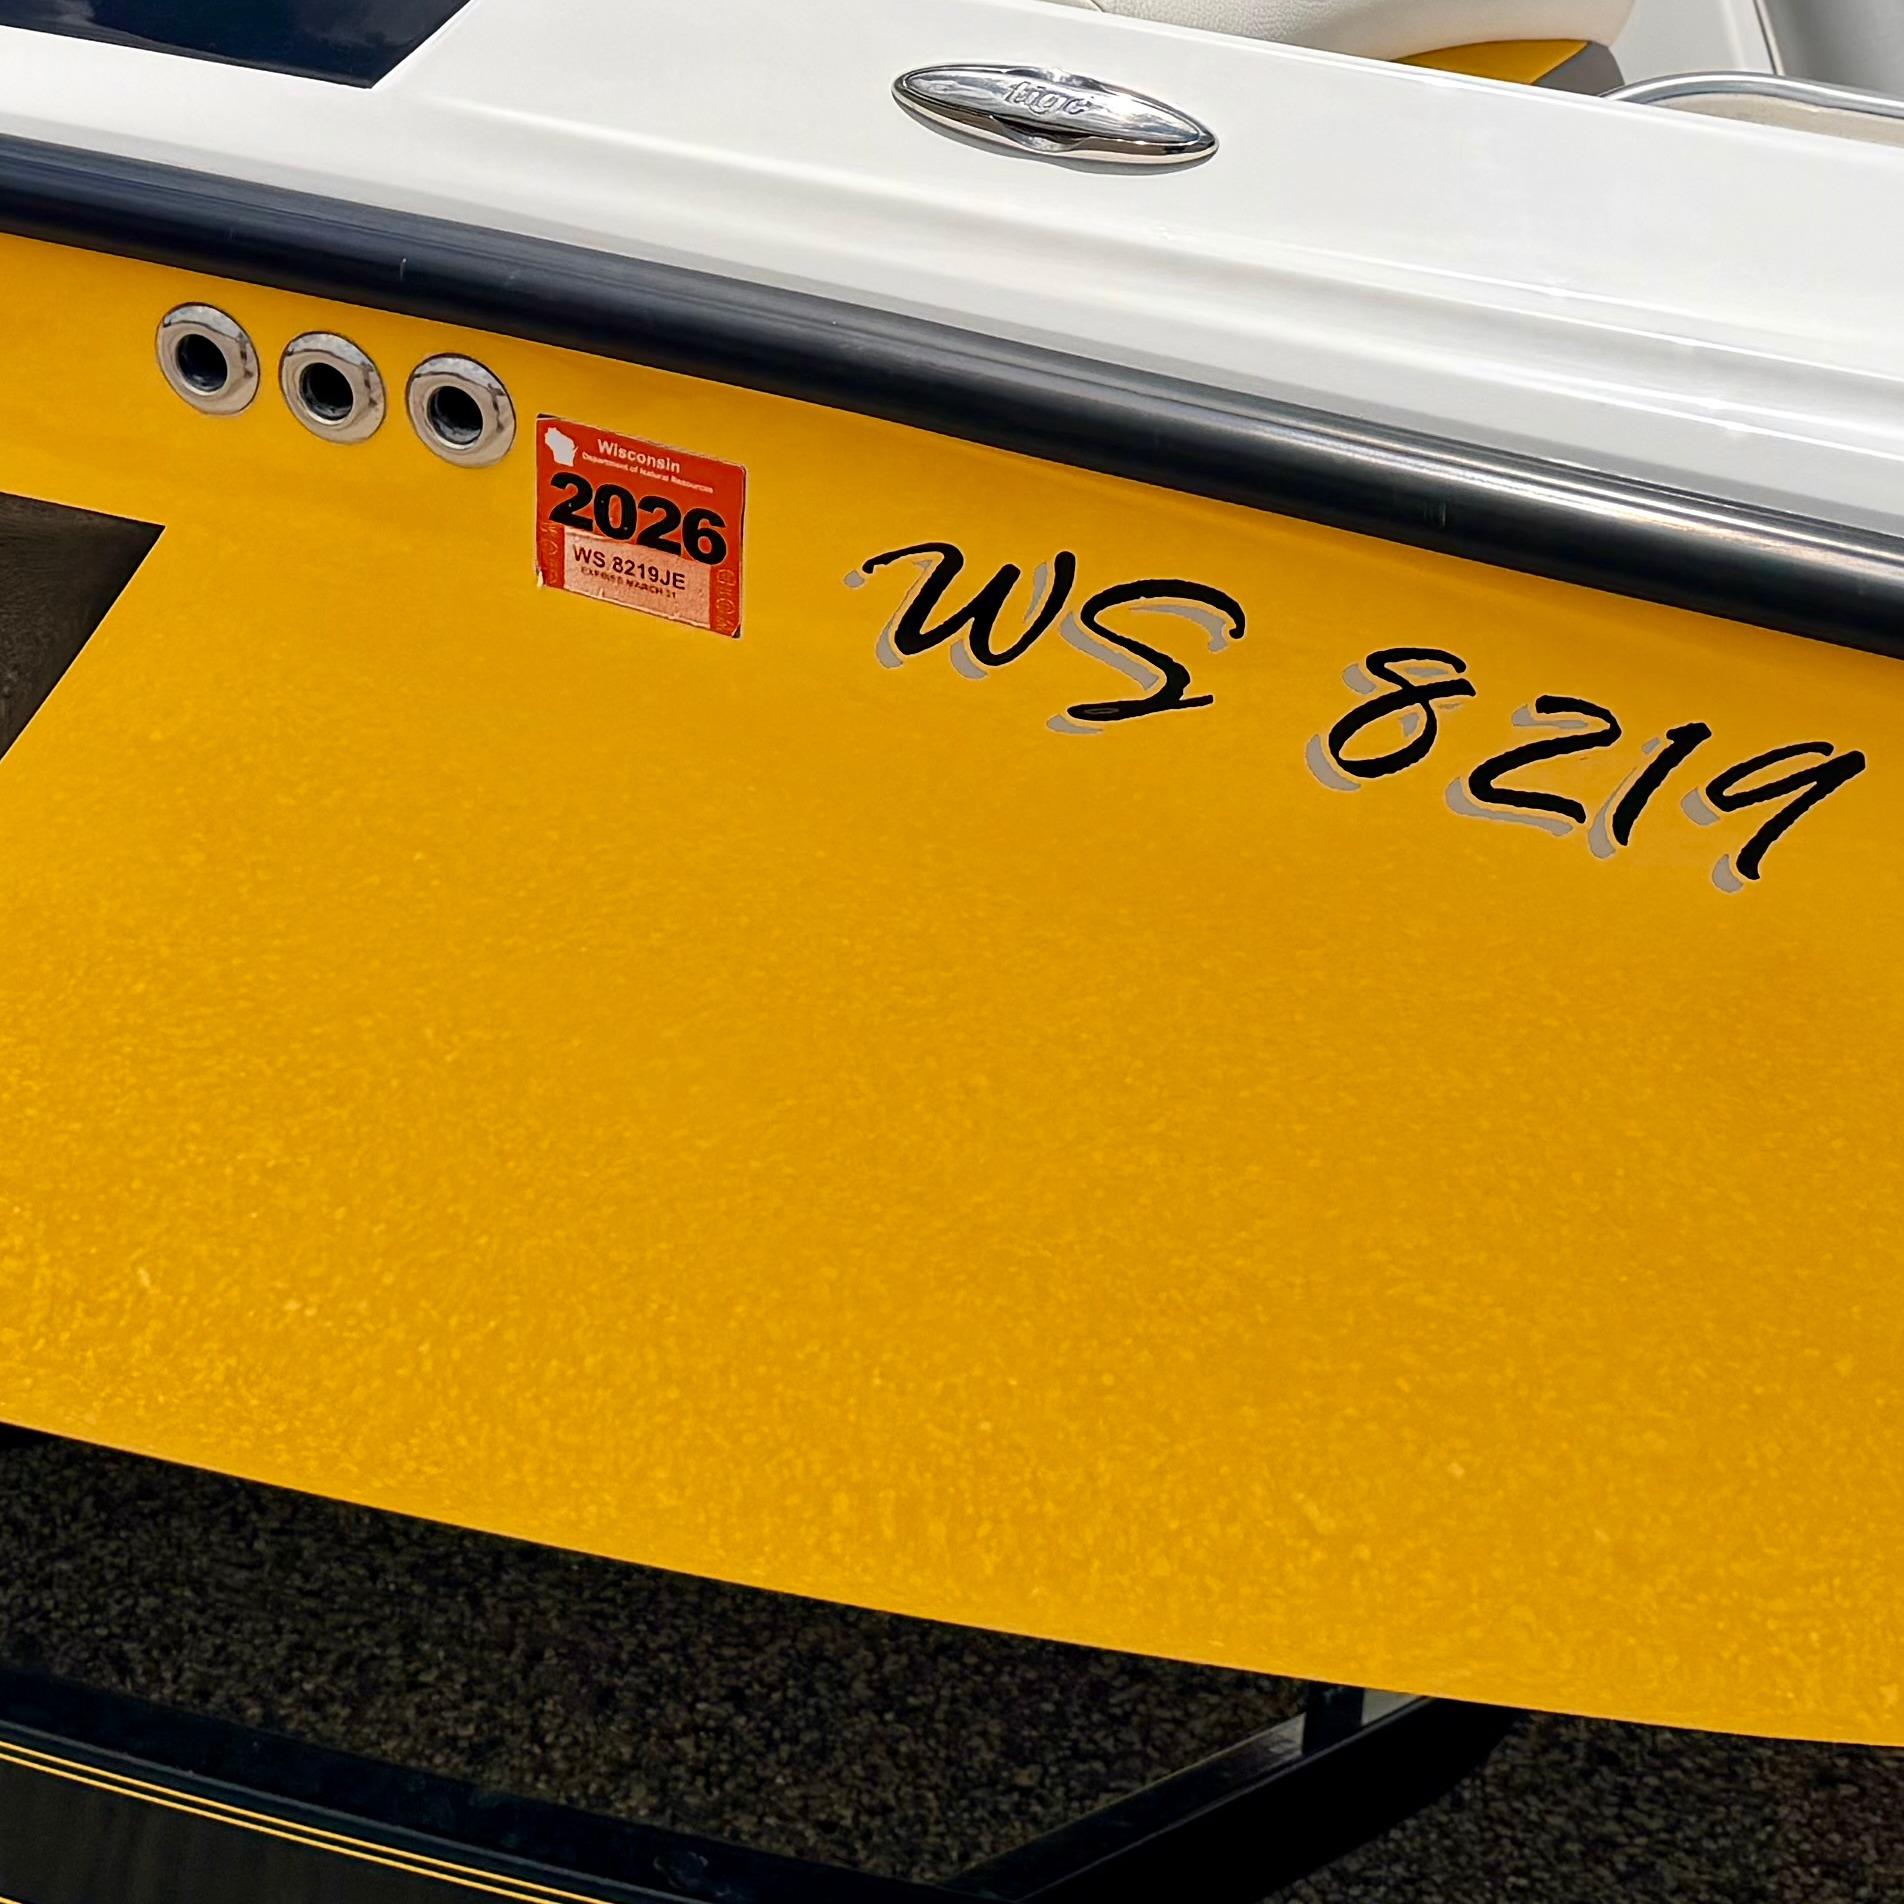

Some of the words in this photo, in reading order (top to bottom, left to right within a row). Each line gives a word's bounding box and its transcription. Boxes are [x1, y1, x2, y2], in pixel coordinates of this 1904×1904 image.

[597, 438, 681, 475] Wisconsin
[549, 471, 728, 566] 2026
[572, 544, 606, 569] WS
[612, 556, 686, 590] 8219JE
[860, 541, 1246, 726] WS
[1326, 646, 1868, 884] 8219
